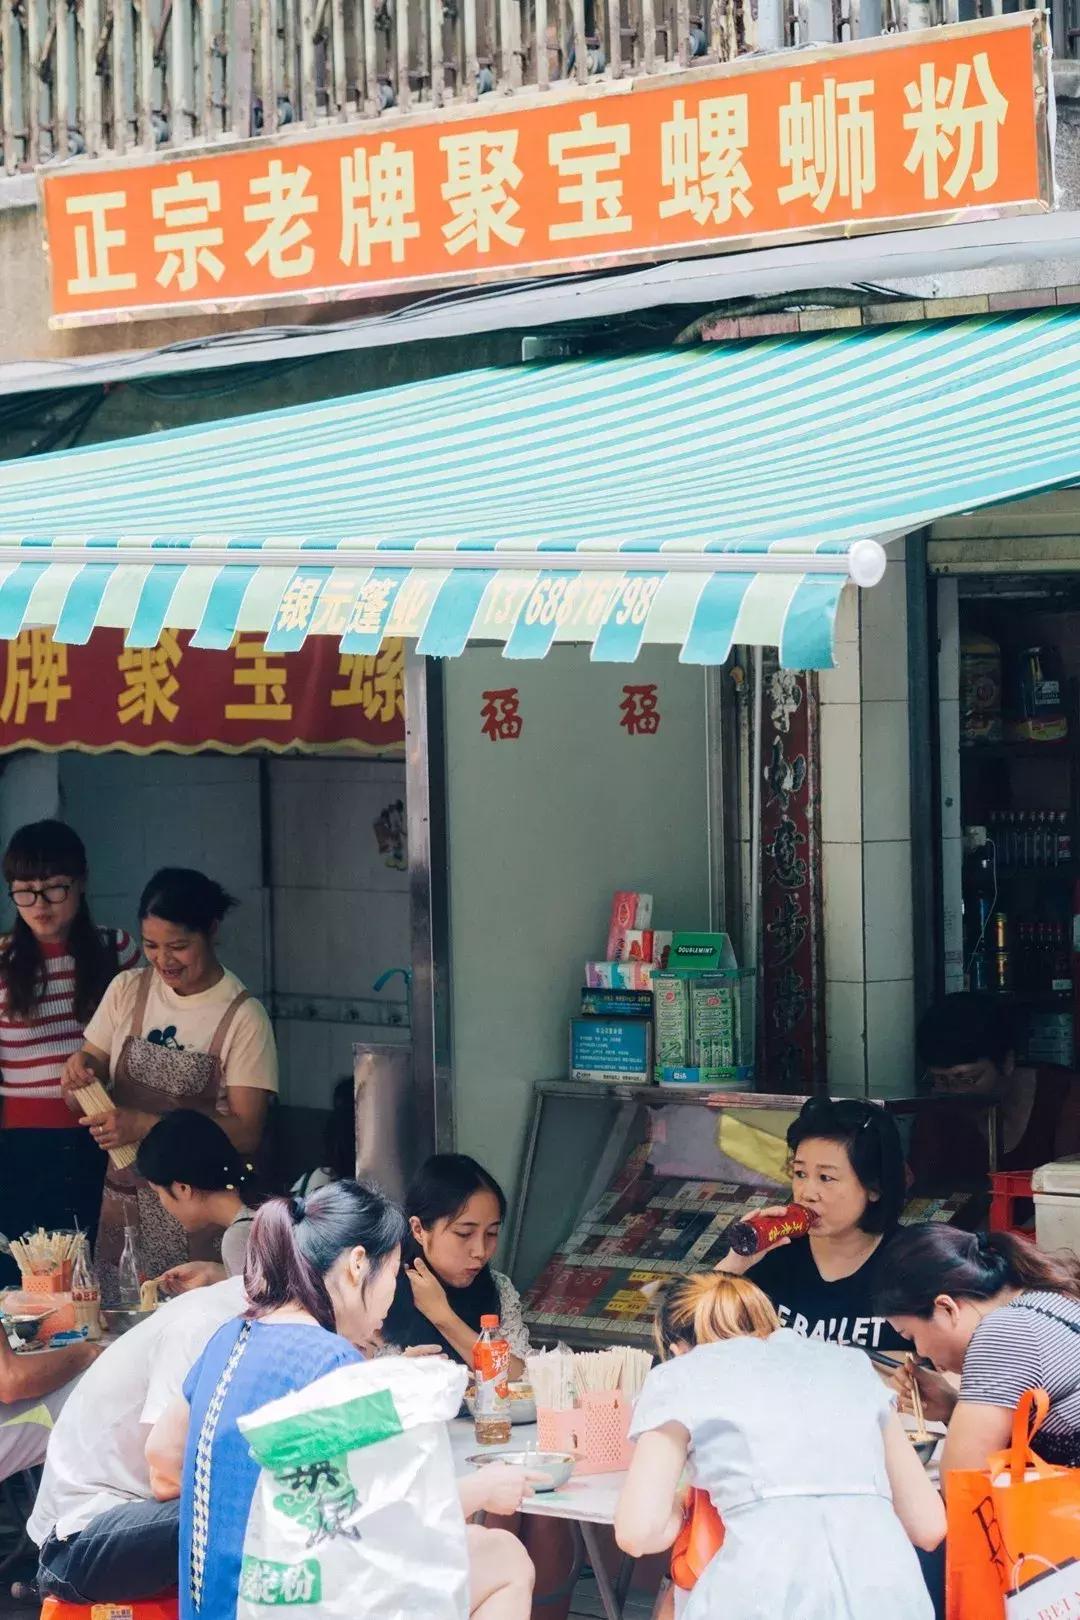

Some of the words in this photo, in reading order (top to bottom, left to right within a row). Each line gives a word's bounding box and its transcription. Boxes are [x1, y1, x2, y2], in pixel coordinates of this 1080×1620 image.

[66, 52, 1009, 296] 正宗老牌聚宝螺蛳粉
[480, 687, 523, 741] 福
[620, 683, 661, 736] 福
[678, 946, 713, 954] DOUBLEMINT
